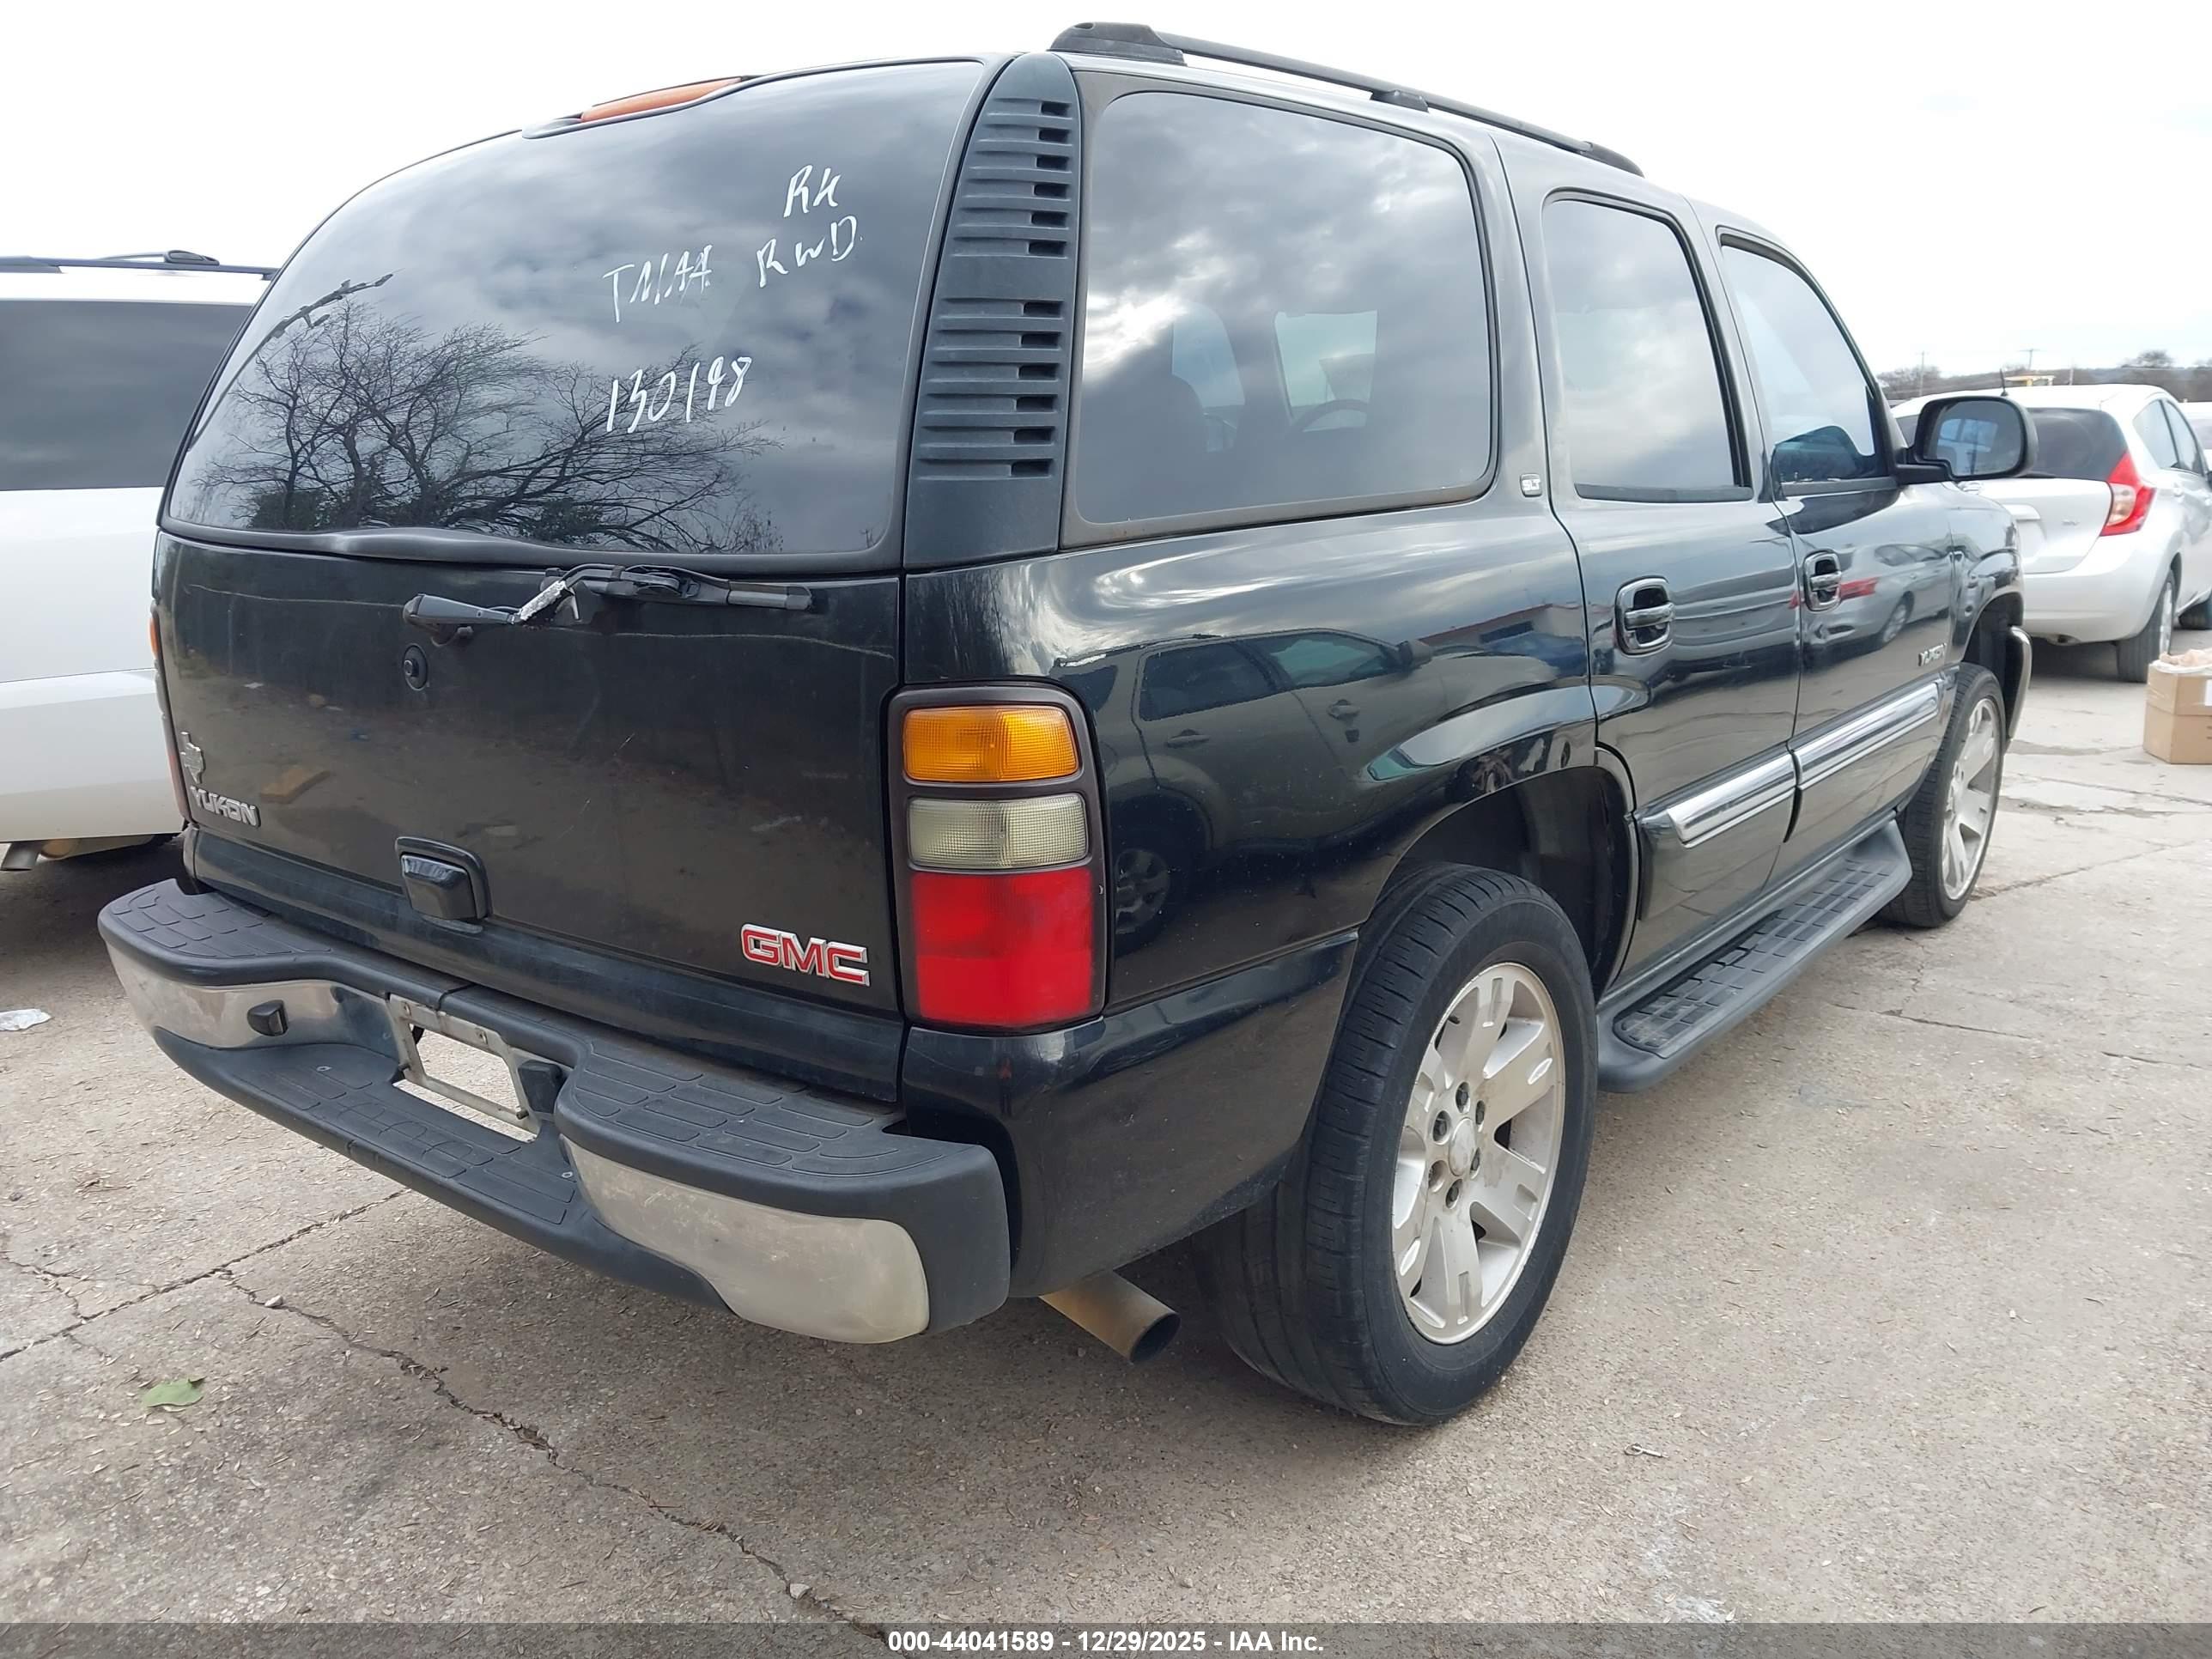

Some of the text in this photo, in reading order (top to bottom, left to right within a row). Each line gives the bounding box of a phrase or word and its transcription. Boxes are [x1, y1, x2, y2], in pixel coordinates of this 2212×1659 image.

[605, 356, 752, 434] 130198
[189, 785, 260, 827] YUKON
[740, 923, 871, 987] GMC
